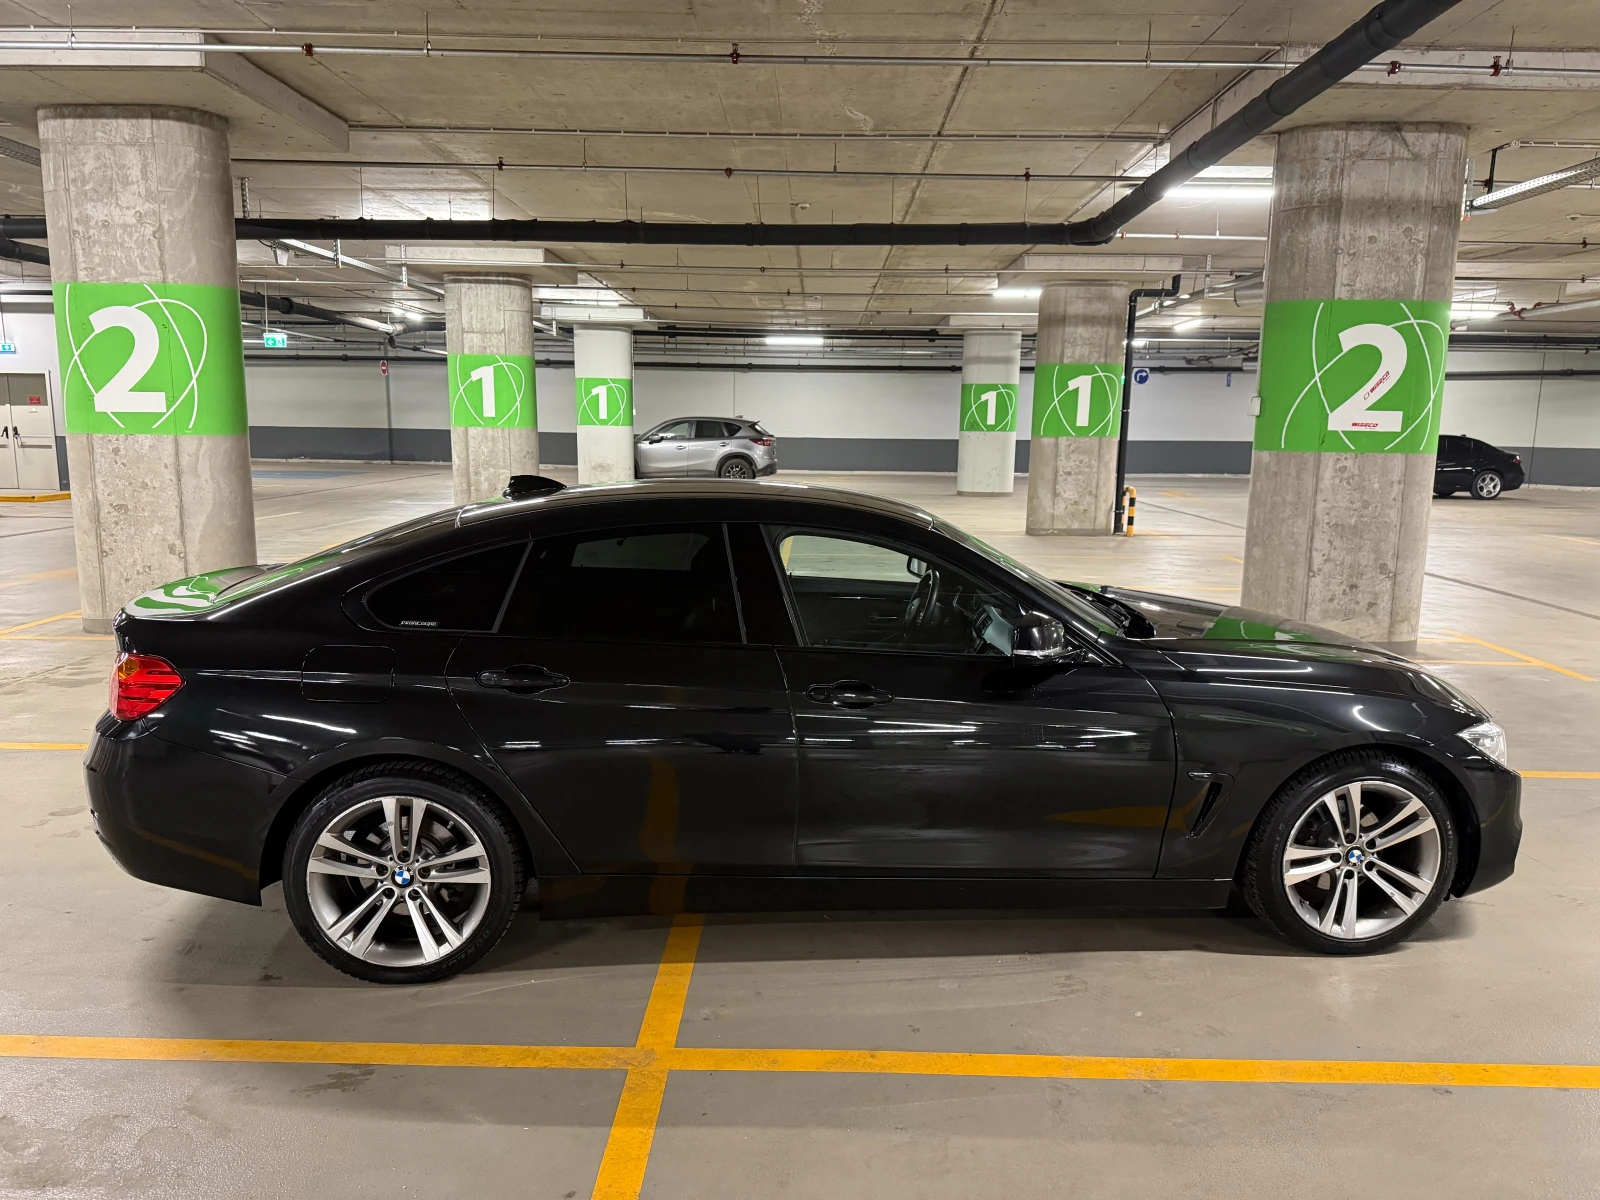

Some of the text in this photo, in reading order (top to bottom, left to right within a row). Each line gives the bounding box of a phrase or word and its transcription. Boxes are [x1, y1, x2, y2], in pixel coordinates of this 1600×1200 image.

[88, 305, 167, 413] 2
[1327, 323, 1408, 433] 2
[470, 365, 496, 418] 1
[591, 385, 608, 420] 1
[980, 390, 997, 425] 1
[1068, 375, 1092, 427] 1
